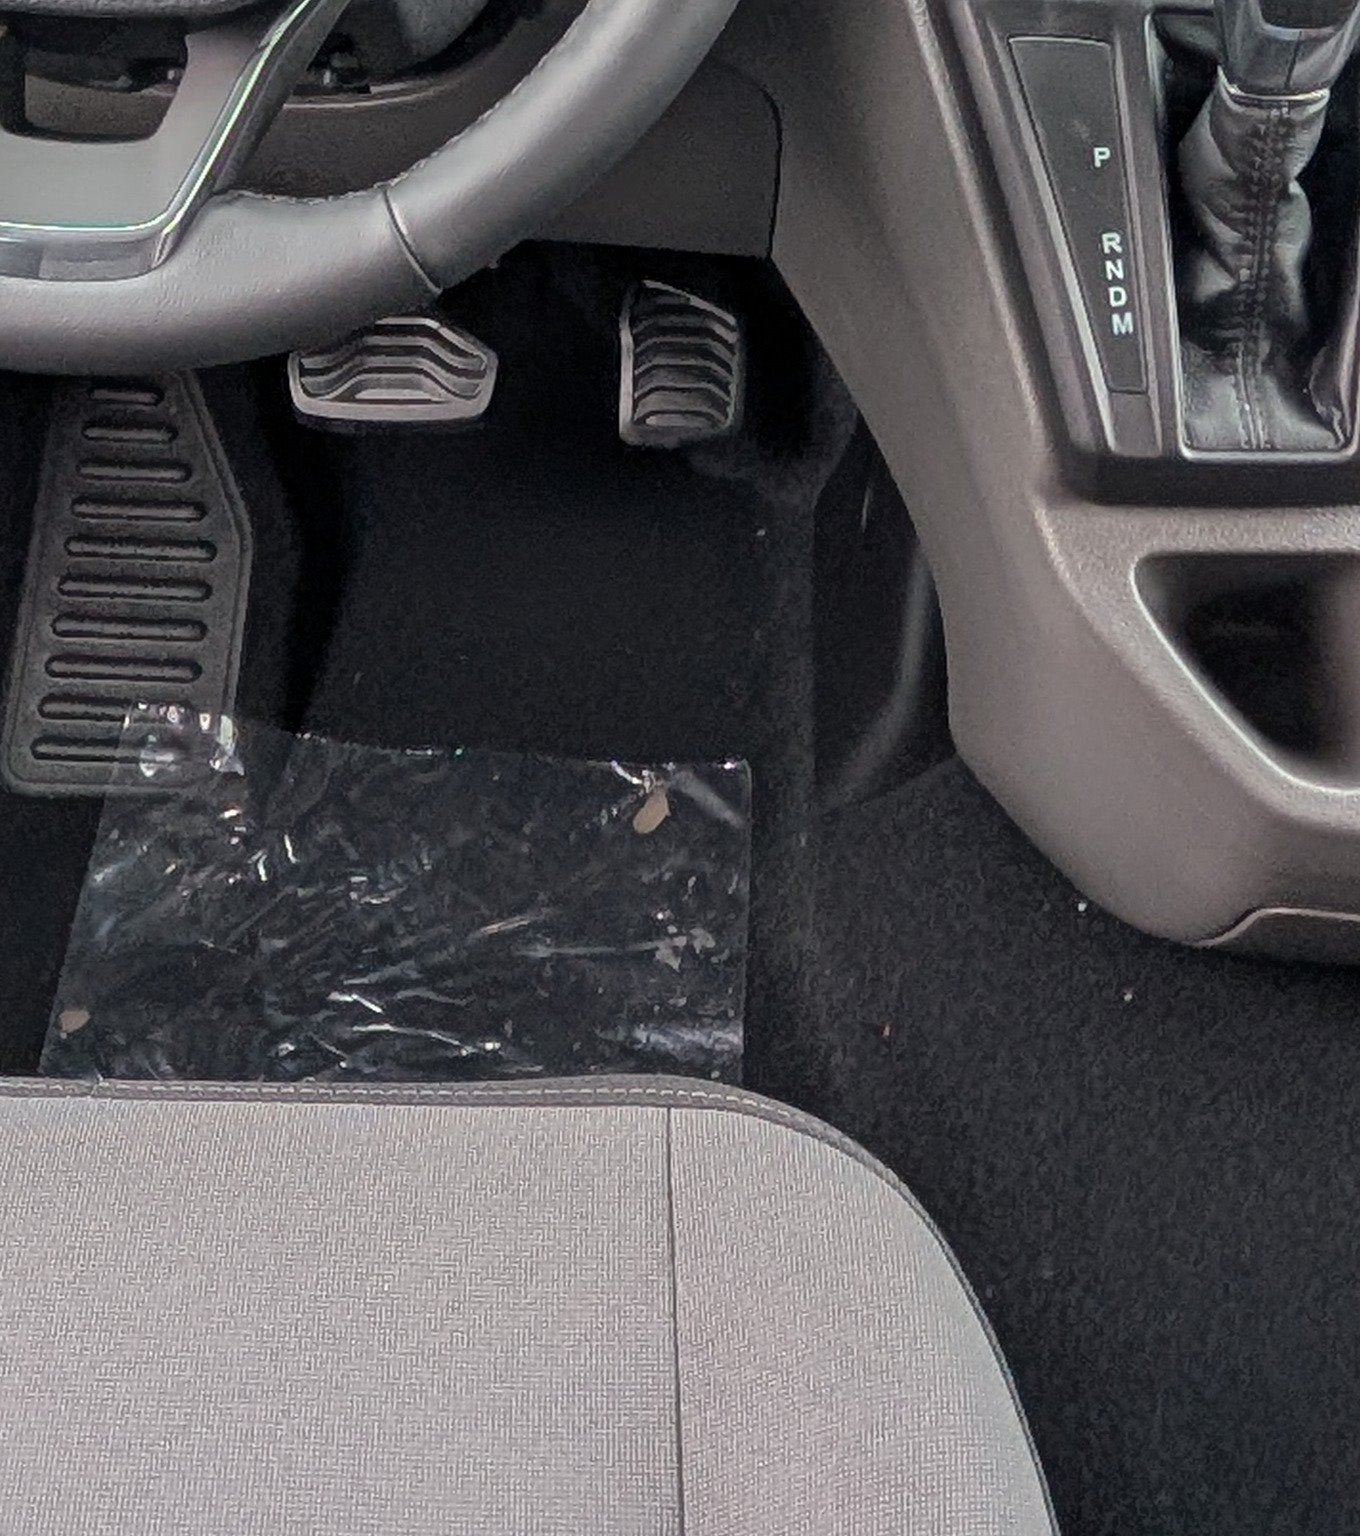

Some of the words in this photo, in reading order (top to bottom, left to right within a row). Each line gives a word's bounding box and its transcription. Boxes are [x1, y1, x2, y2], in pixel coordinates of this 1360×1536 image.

[1093, 146, 1111, 167] P
[1101, 232, 1122, 254] R
[1105, 259, 1124, 280] N
[1108, 286, 1128, 307] D
[1112, 312, 1134, 335] M
